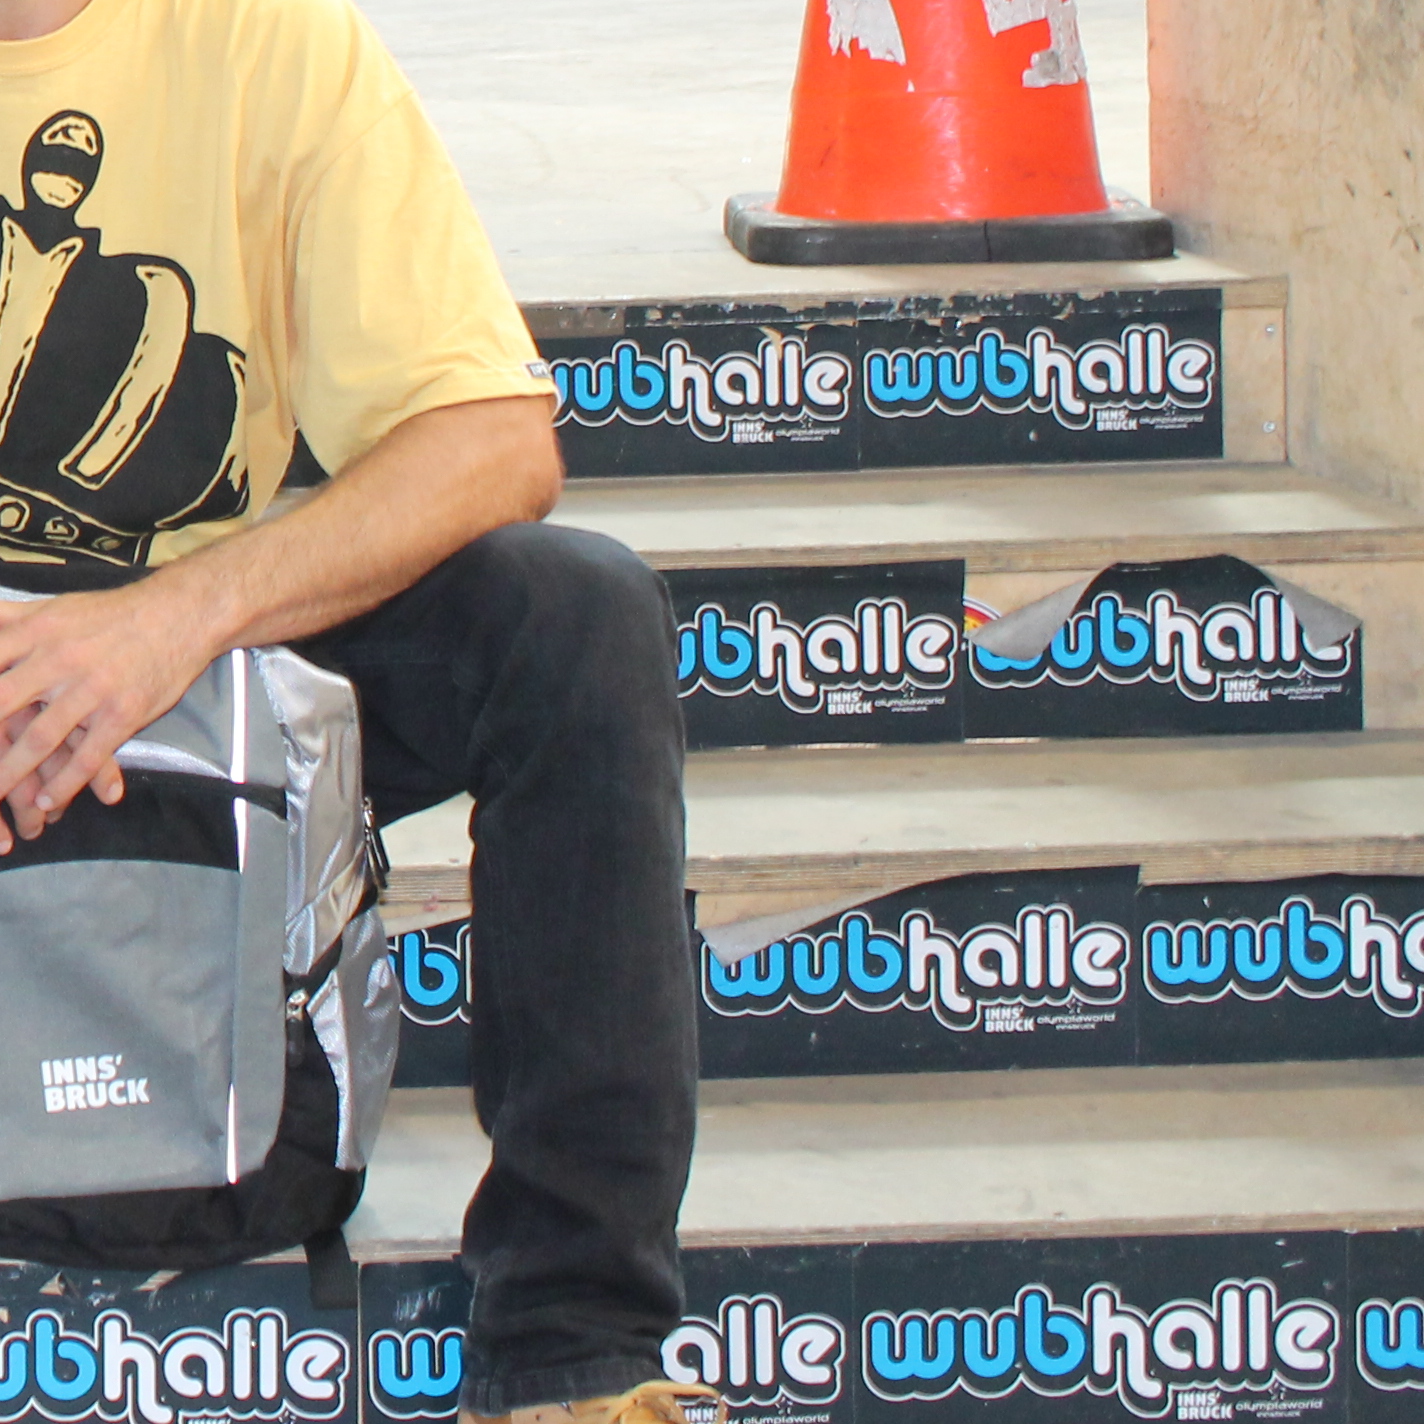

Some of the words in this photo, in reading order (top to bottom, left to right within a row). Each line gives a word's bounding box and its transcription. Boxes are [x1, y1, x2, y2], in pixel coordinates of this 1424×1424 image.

[866, 328, 1213, 418] wubhalle
[732, 432, 774, 444] BRUCK
[1096, 420, 1138, 432] BRUCK
[678, 605, 951, 697] bhalle
[827, 702, 873, 716] BRUCK
[1223, 690, 1270, 704] BRUCK
[1150, 902, 1424, 1000] wubh
[985, 1019, 1034, 1033] BRUCK
[41, 1053, 123, 1087] INNS'
[44, 1077, 151, 1114] BRUCK
[870, 1287, 1331, 1399] wubhalle
[1178, 1405, 1233, 1421] BRUCK
